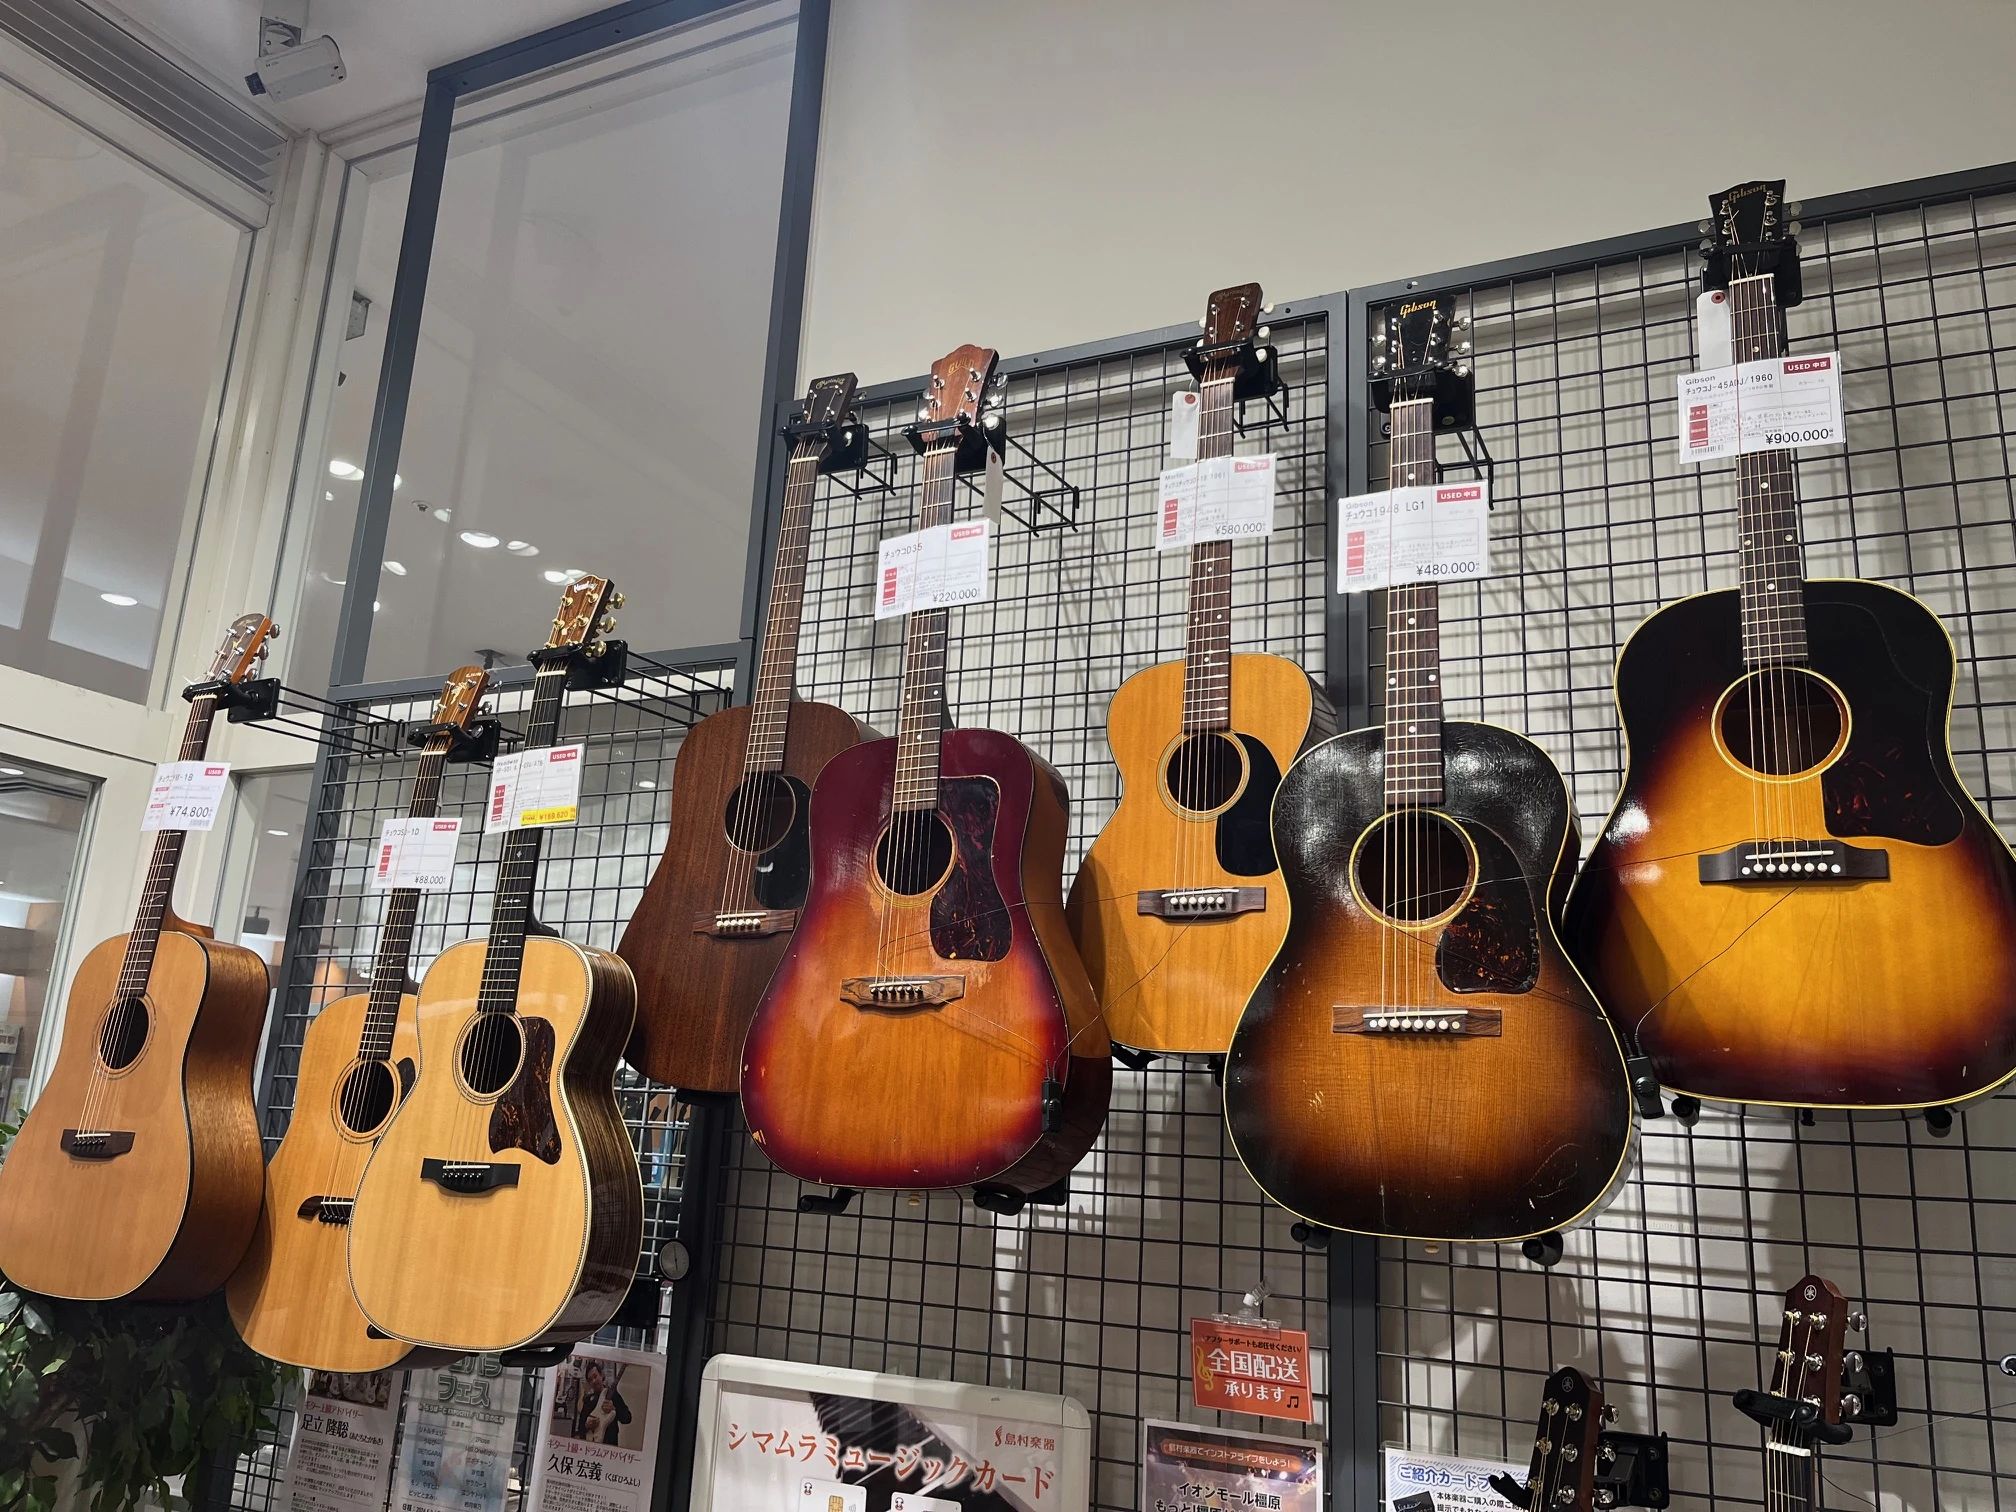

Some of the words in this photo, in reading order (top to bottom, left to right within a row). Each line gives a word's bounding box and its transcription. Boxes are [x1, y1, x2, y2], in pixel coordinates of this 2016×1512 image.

[1728, 184, 1768, 203] Gibson
[1400, 300, 1437, 318] Gibson
[948, 357, 975, 373] GUILD
[1788, 363, 1810, 371] USED
[1686, 375, 1715, 385] Gibson
[1766, 429, 1829, 444] ¥900,000
[1346, 500, 1374, 509] Gibson
[1441, 492, 1462, 500] USED
[1406, 501, 1424, 512] LG1
[953, 529, 970, 538] USED
[1216, 522, 1262, 535] ¥580,000
[1416, 562, 1475, 576] ¥480,000
[1207, 1348, 1300, 1383] 全国配送
[438, 1375, 490, 1408] フェス
[1225, 1379, 1285, 1402] 承ります
[301, 1413, 324, 1434] 足立
[1004, 1432, 1055, 1451] 島村楽器
[547, 1454, 573, 1475] 久保
[575, 1459, 602, 1481] 宏義
[728, 1423, 1055, 1499] シマムラミュージックカード
[1179, 1483, 1281, 1511] イオンモール橿原
